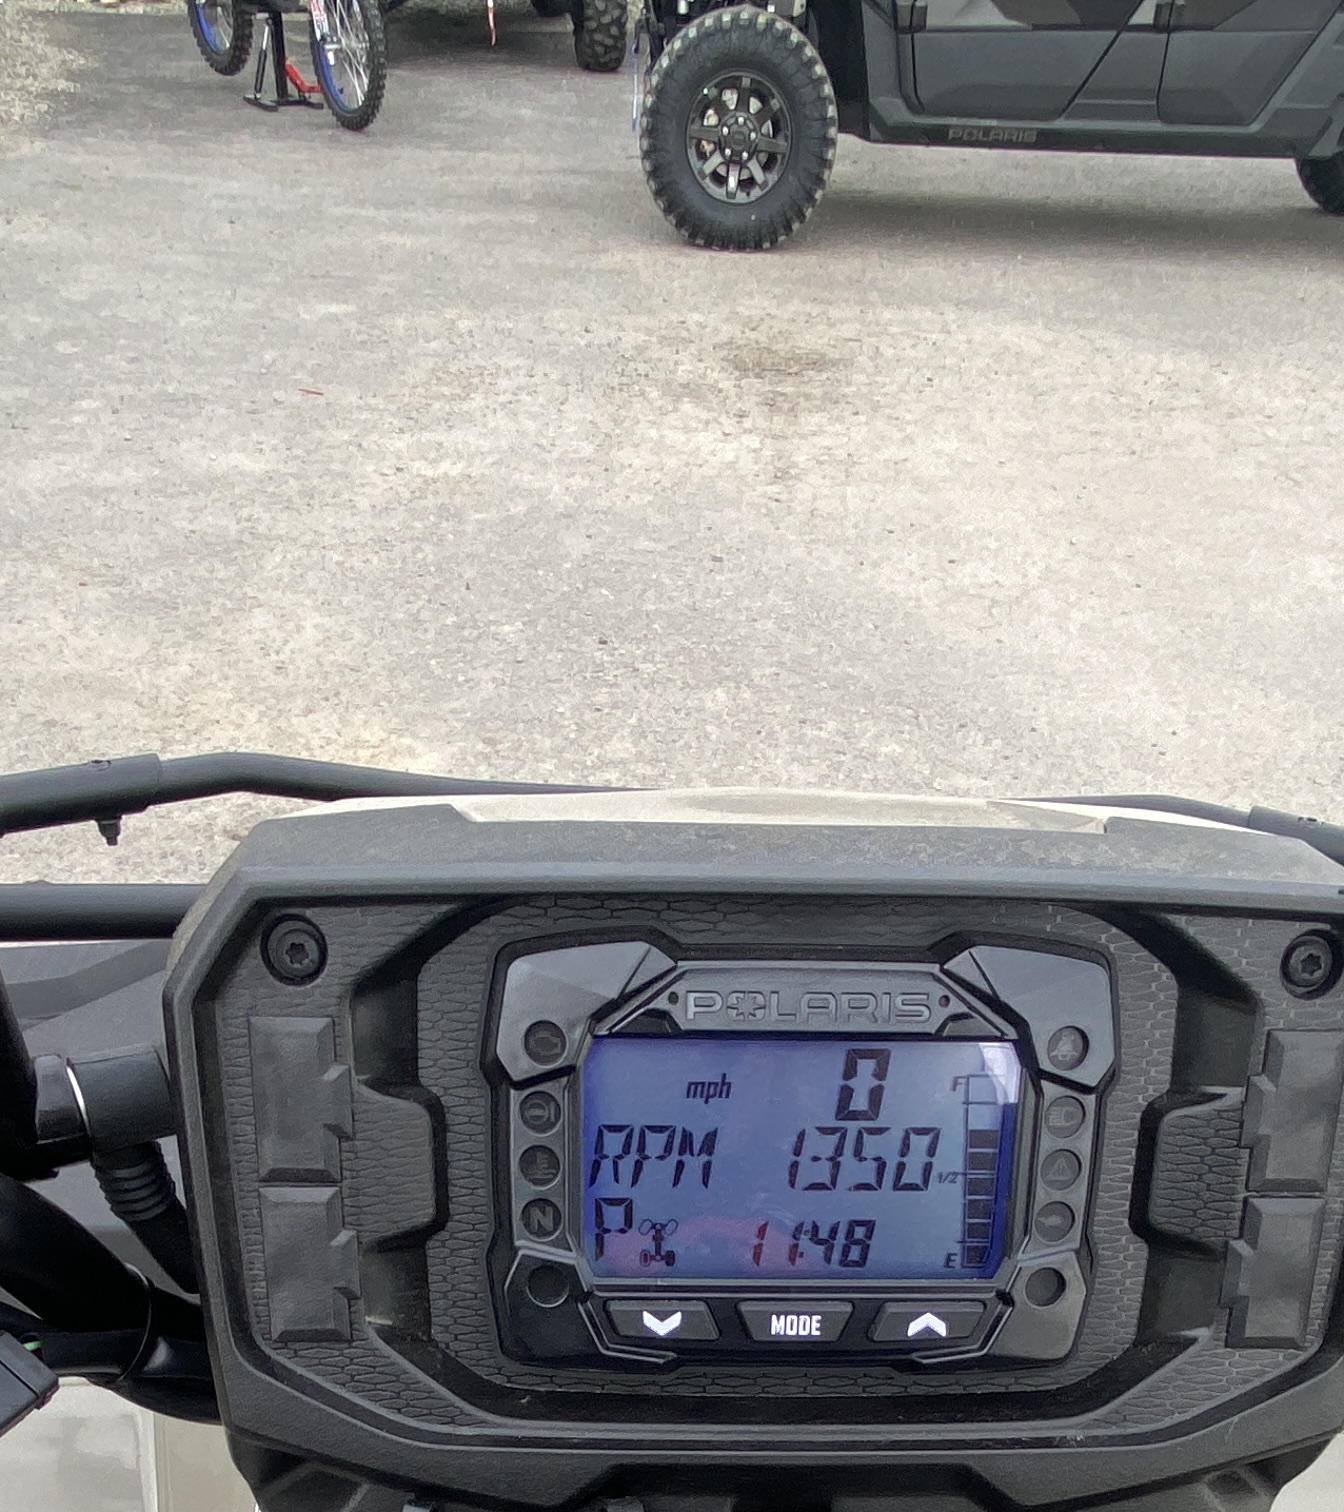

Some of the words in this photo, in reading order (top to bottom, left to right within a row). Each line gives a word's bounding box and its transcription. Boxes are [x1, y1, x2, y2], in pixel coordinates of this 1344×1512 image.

[948, 127, 1037, 143] POLARIS
[685, 989, 932, 1022] POLARIS
[685, 1075, 731, 1104] mph
[835, 1048, 890, 1121] 0
[589, 1124, 717, 1190] RPM
[788, 1126, 941, 1192] 1350
[594, 1198, 633, 1261] P
[943, 1253, 958, 1269] E
[770, 1314, 821, 1337] MODE
